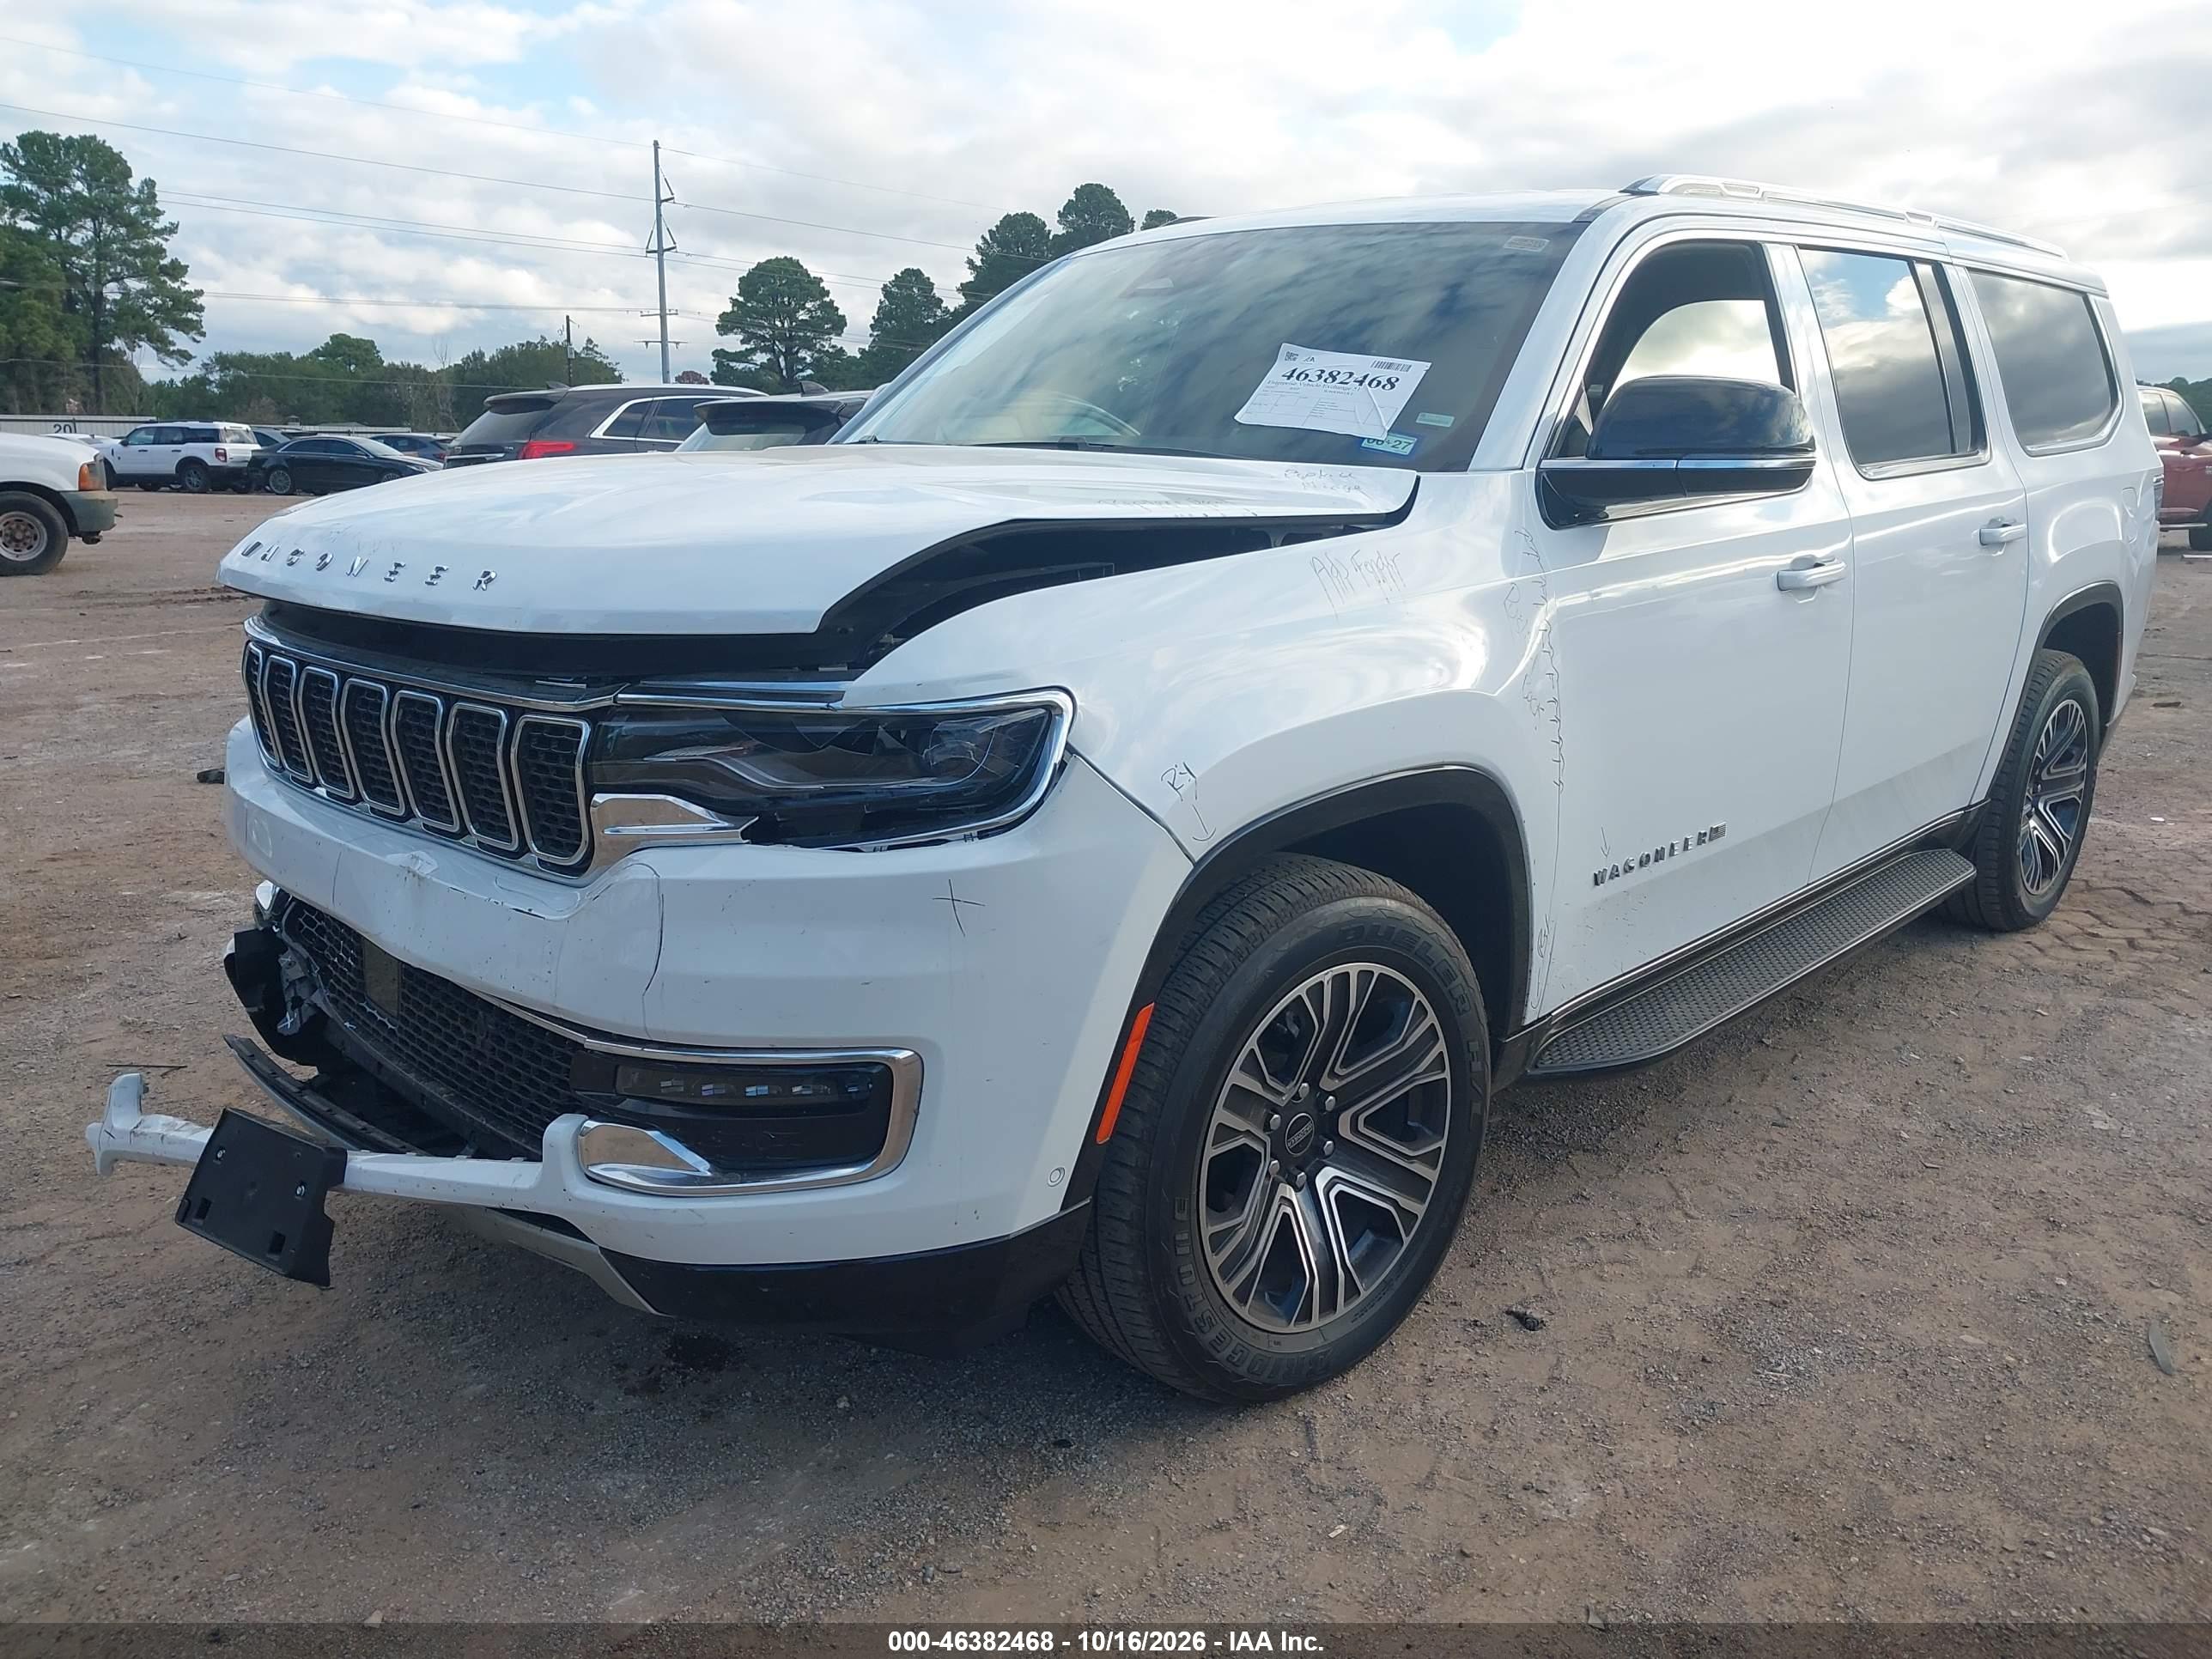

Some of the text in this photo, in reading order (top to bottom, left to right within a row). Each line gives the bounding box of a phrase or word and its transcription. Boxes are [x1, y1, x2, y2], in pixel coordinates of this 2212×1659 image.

[1281, 367, 1401, 391] 46382468
[1391, 440, 1413, 450] 27
[241, 541, 497, 591] WAGONEER
[1593, 830, 1708, 886] WAGONEER
[1339, 923, 1472, 1016] DUELER
[1174, 1196, 1330, 1379] BRIDGESTONE
